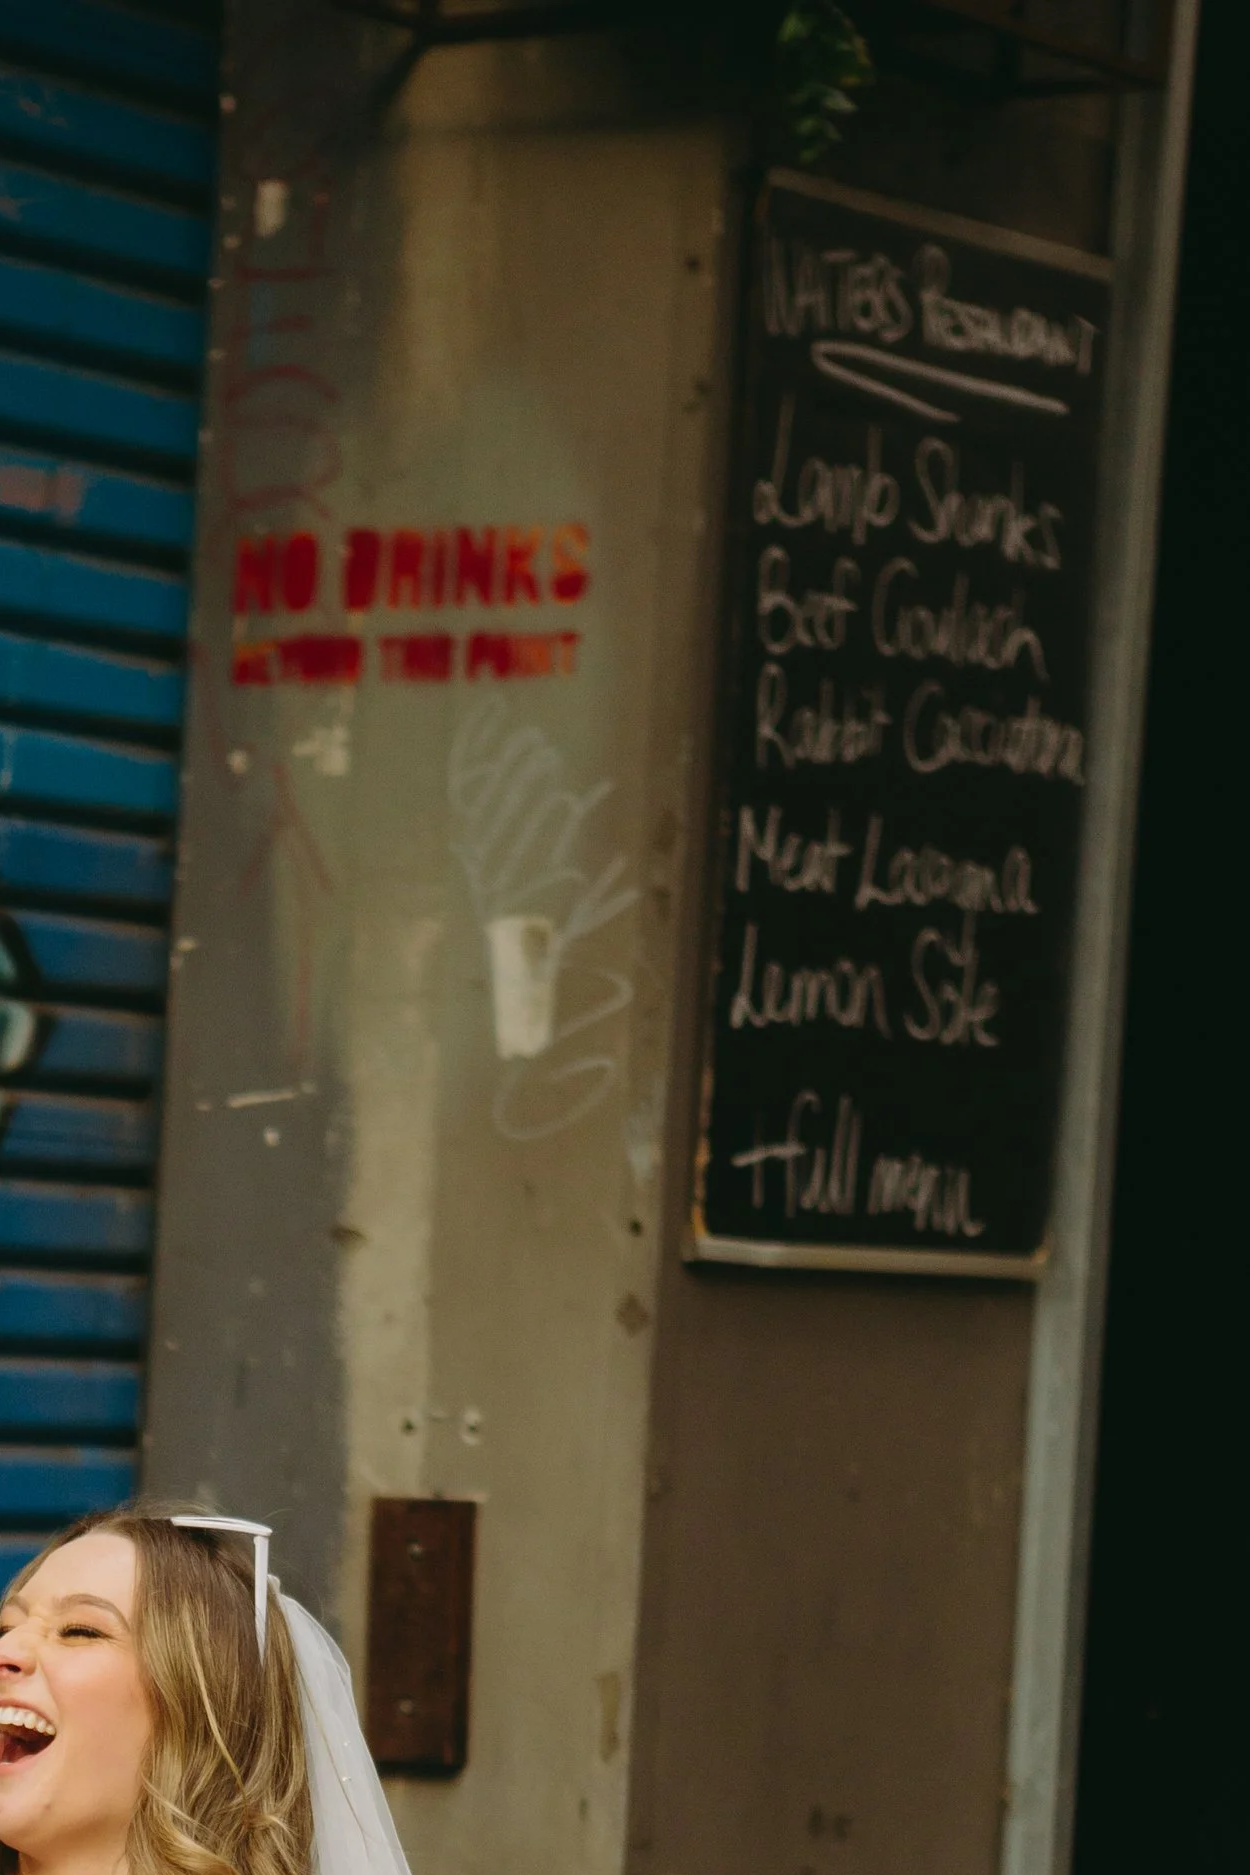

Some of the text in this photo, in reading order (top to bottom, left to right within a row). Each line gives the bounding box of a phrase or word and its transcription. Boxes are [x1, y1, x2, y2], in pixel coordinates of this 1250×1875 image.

[753, 393, 900, 546] Lamb
[234, 524, 590, 614] NO DRINKS
[729, 922, 893, 1041] Lemon
